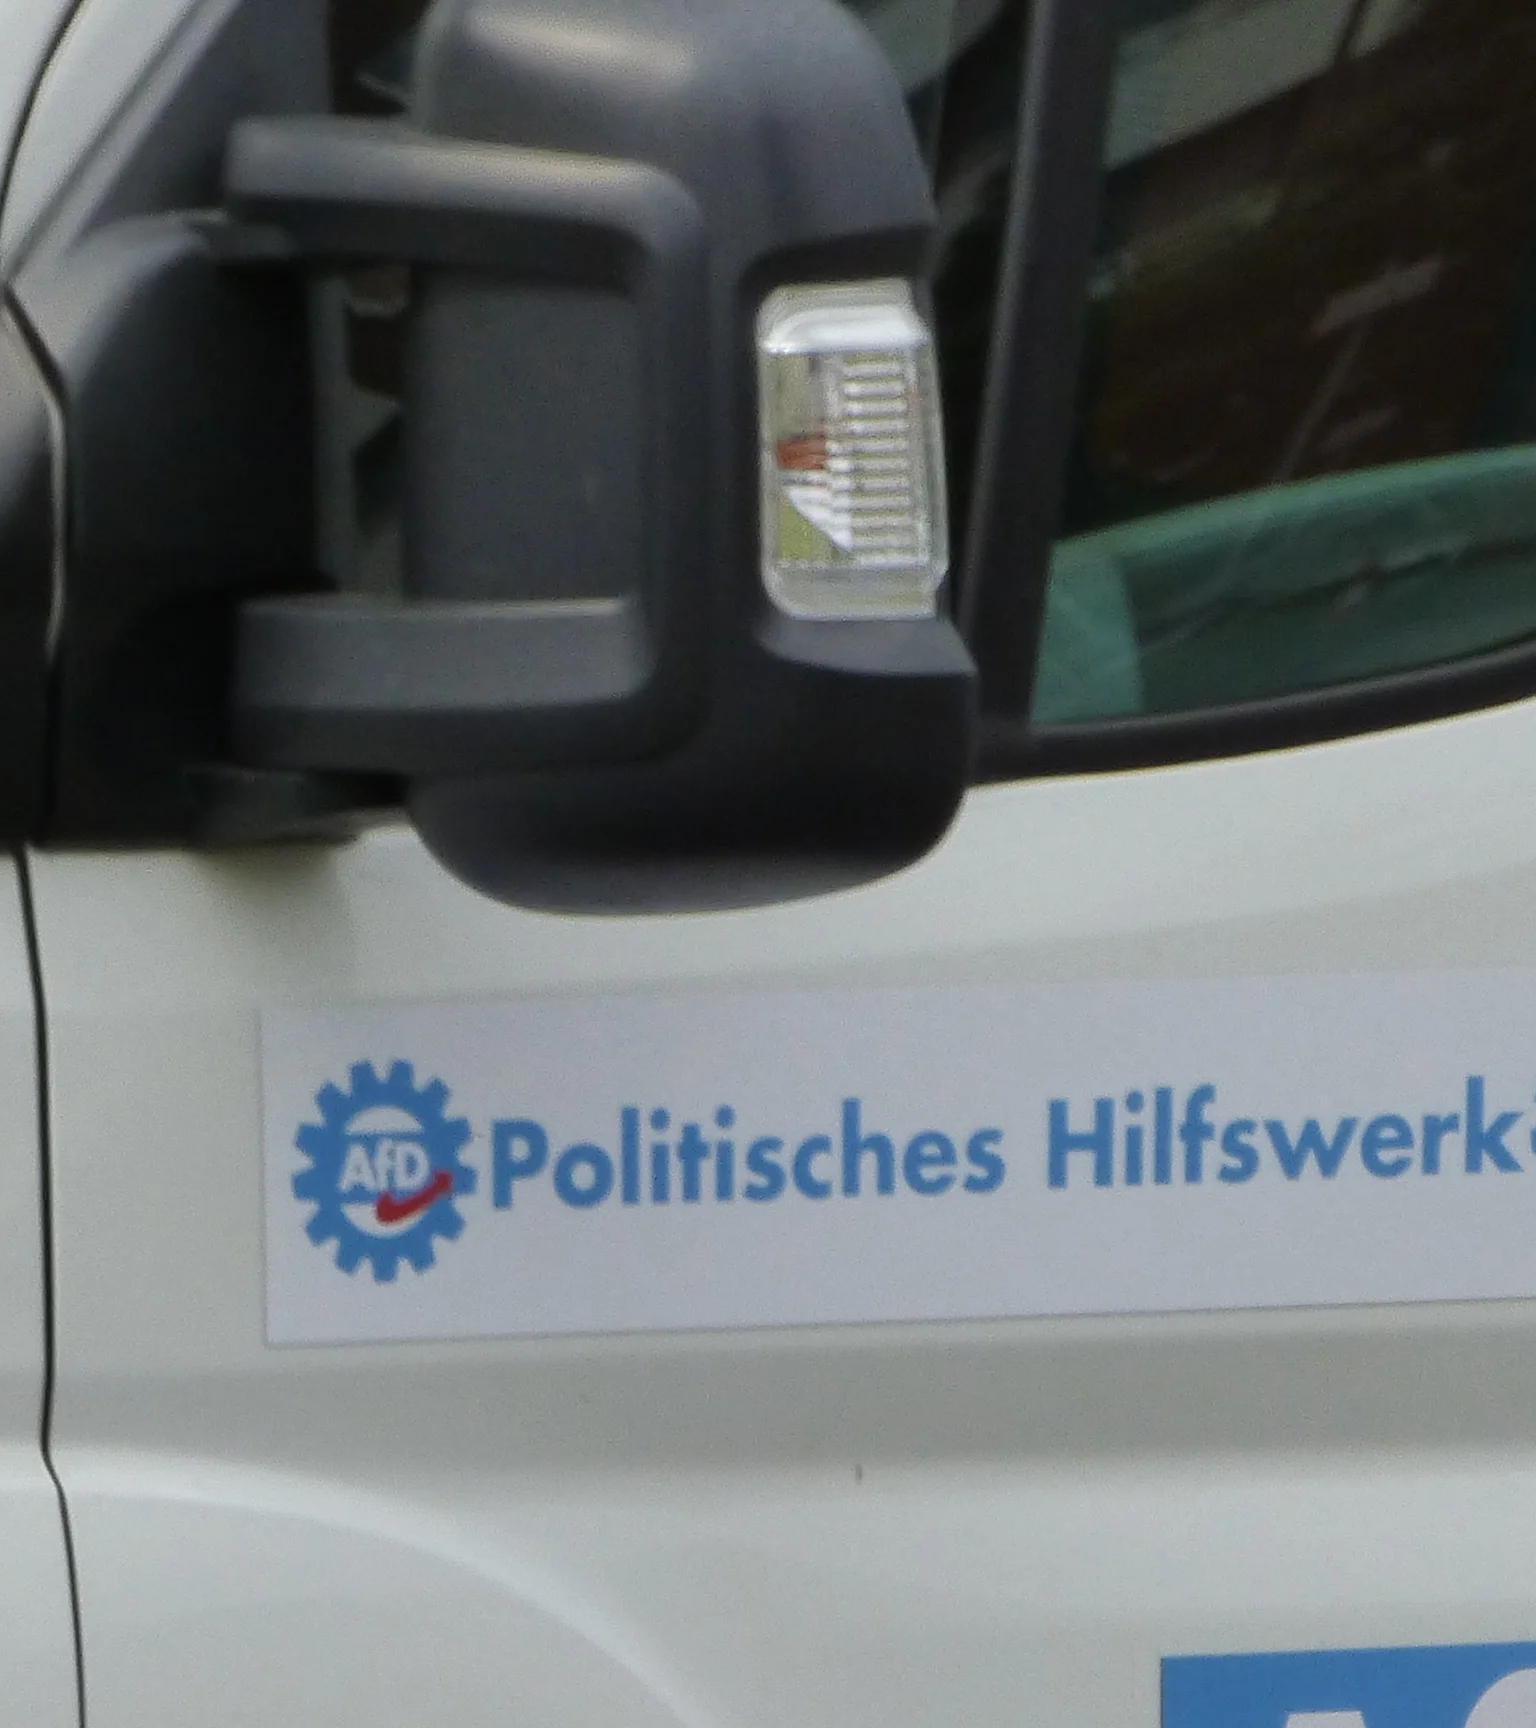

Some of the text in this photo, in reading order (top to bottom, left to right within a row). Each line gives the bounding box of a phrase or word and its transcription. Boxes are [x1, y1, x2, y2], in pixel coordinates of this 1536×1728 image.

[337, 1141, 430, 1194] AfD
[491, 1098, 1006, 1209] Politisches
[1046, 1075, 1524, 1189] Hilfswerk
